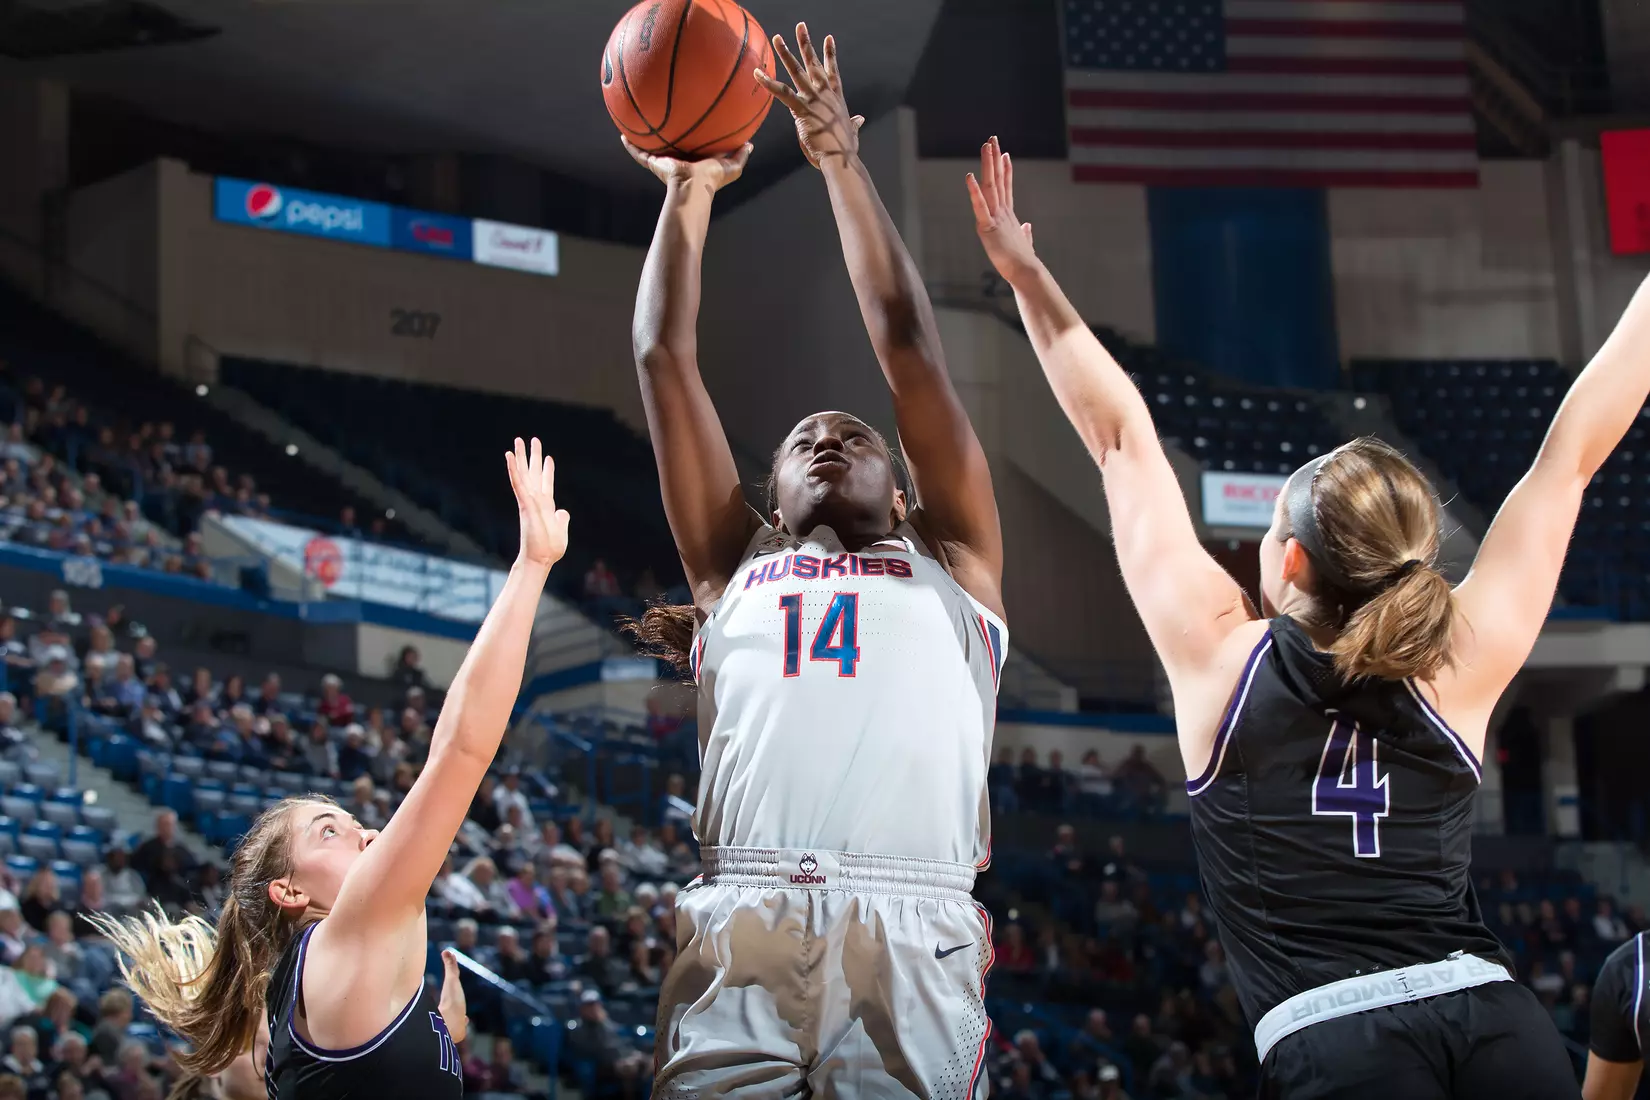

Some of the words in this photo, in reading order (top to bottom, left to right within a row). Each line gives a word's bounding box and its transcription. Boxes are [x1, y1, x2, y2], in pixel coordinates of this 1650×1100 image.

[286, 200, 363, 232] pepsi
[390, 307, 442, 340] 207
[1223, 483, 1282, 501] RICO
[743, 552, 914, 592] HUSKIES
[779, 591, 861, 678] 14
[1311, 708, 1390, 858] 4
[789, 874, 827, 884] UCONN
